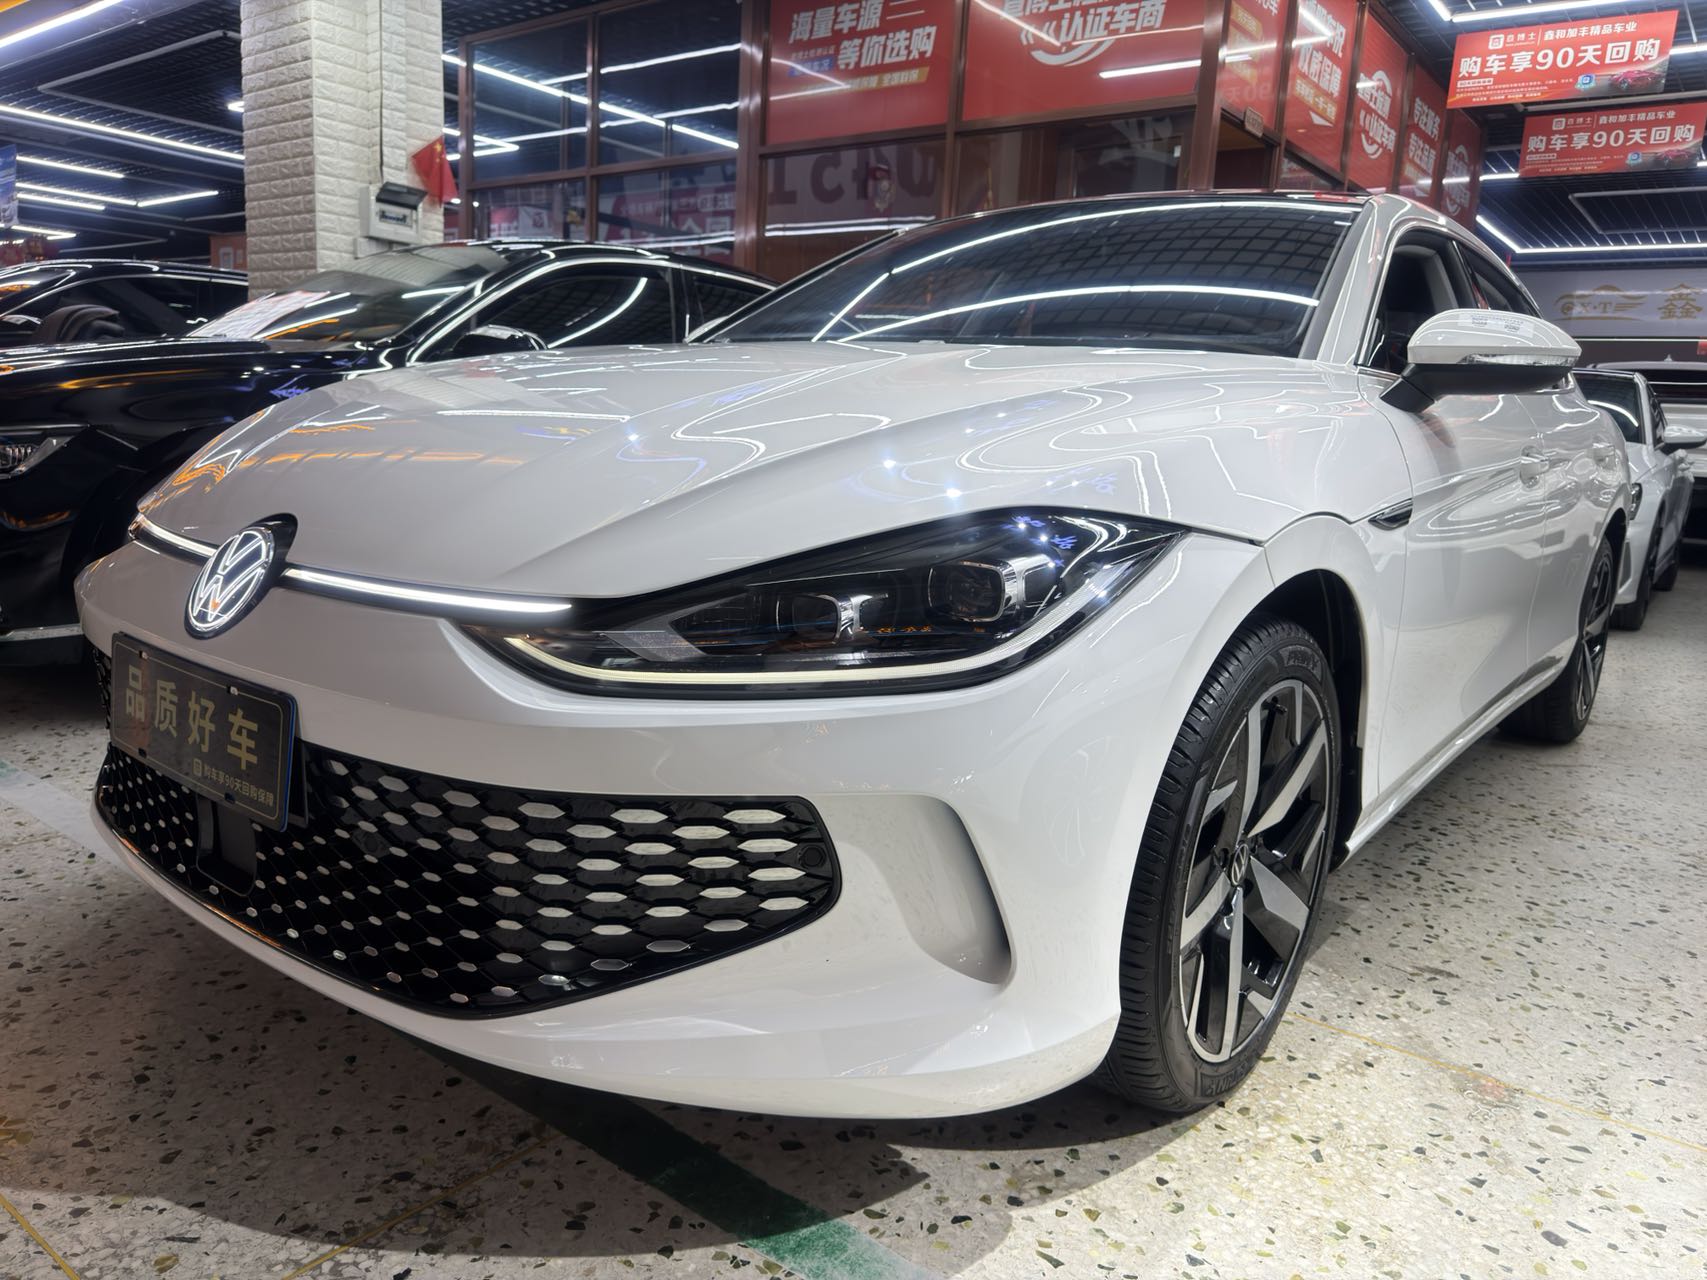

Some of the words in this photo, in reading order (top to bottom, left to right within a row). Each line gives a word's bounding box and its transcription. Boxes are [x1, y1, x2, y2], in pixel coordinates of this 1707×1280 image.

[788, 0, 884, 44] 海量车源
[1059, 0, 1168, 43] 认证车商
[1544, 21, 1637, 41] 鑫和加丰精品车业
[837, 26, 938, 70] 等你选购
[1458, 38, 1661, 78] 购车享90天回购
[1527, 123, 1696, 152] 购车享90天回购
[1657, 283, 1703, 320] 鑫
[125, 664, 258, 770] 品质好车
